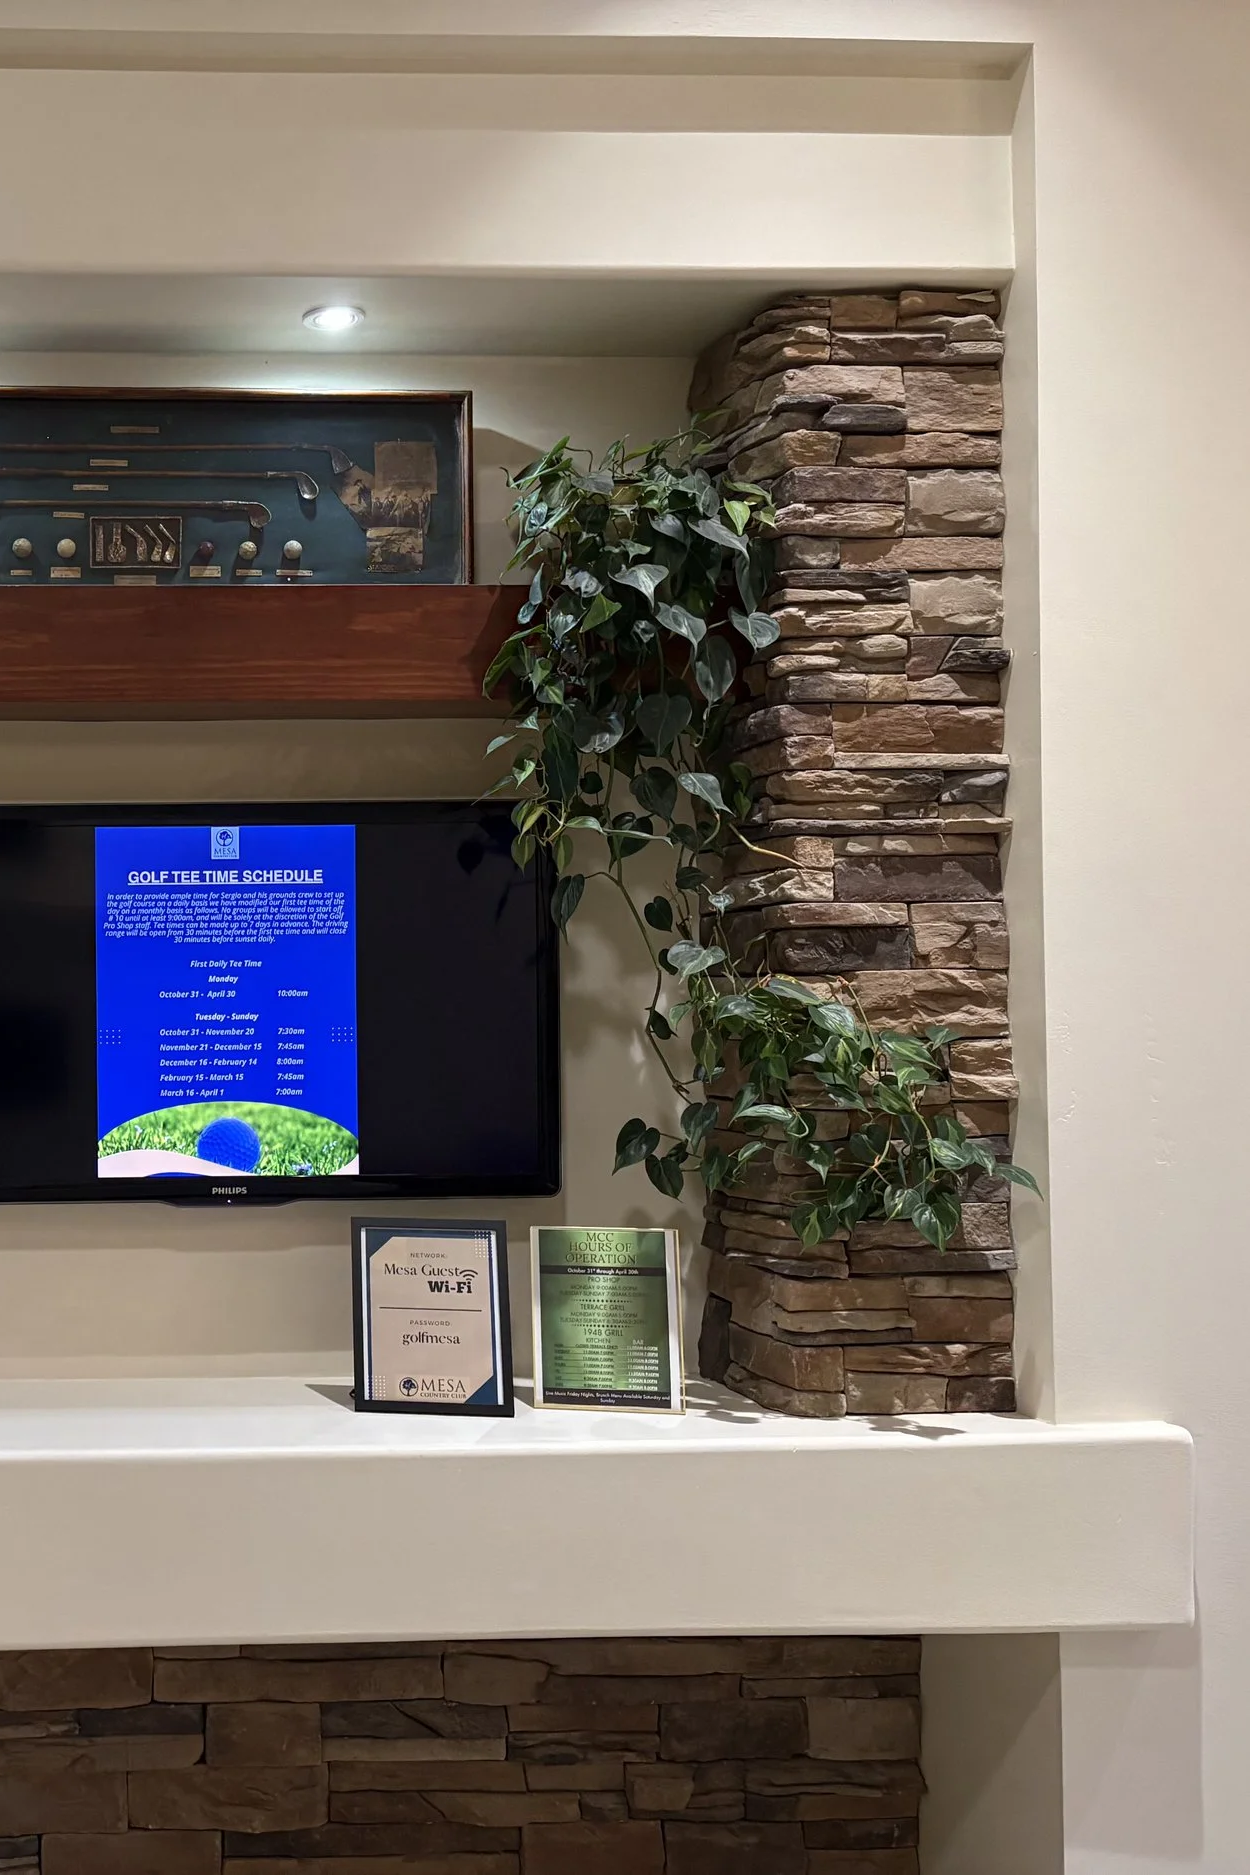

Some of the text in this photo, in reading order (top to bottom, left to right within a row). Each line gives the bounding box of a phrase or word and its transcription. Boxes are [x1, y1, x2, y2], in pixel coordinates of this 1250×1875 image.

[128, 870, 323, 883] GOLF TEE TIME SCHEDULE
[144, 893, 169, 901] provide
[171, 893, 191, 901] ample
[209, 892, 219, 900] for
[221, 892, 241, 900] Sergio
[269, 892, 296, 900] grounds
[174, 900, 189, 908] daily
[238, 899, 267, 907] modified
[282, 899, 295, 907] first
[107, 908, 120, 916] day
[138, 907, 165, 915] monthly
[333, 906, 343, 914] off
[234, 914, 252, 922] solely
[330, 913, 344, 921] Golf
[117, 922, 133, 930] Shop
[135, 922, 151, 930] staff.
[255, 921, 270, 929] days
[325, 920, 348, 928] driving
[167, 929, 183, 937] from
[224, 929, 245, 937] before
[259, 928, 272, 936] first
[212, 936, 233, 944] before
[209, 960, 228, 969] Daily
[208, 975, 238, 984] Monday
[207, 991, 224, 999] April
[195, 1013, 259, 1022] Tuesday Sunday
[213, 1059, 246, 1067] February
[160, 1074, 193, 1083] February
[200, 1089, 218, 1097] April
[587, 1233, 614, 1242] MCC
[570, 1242, 631, 1252] HOURS OF
[566, 1253, 636, 1264] OPERATION
[384, 1263, 460, 1276] Mesa Guest
[428, 1281, 472, 1293] Wi-Fi
[402, 1332, 460, 1345] golfmesa
[421, 1378, 466, 1392] MESA
